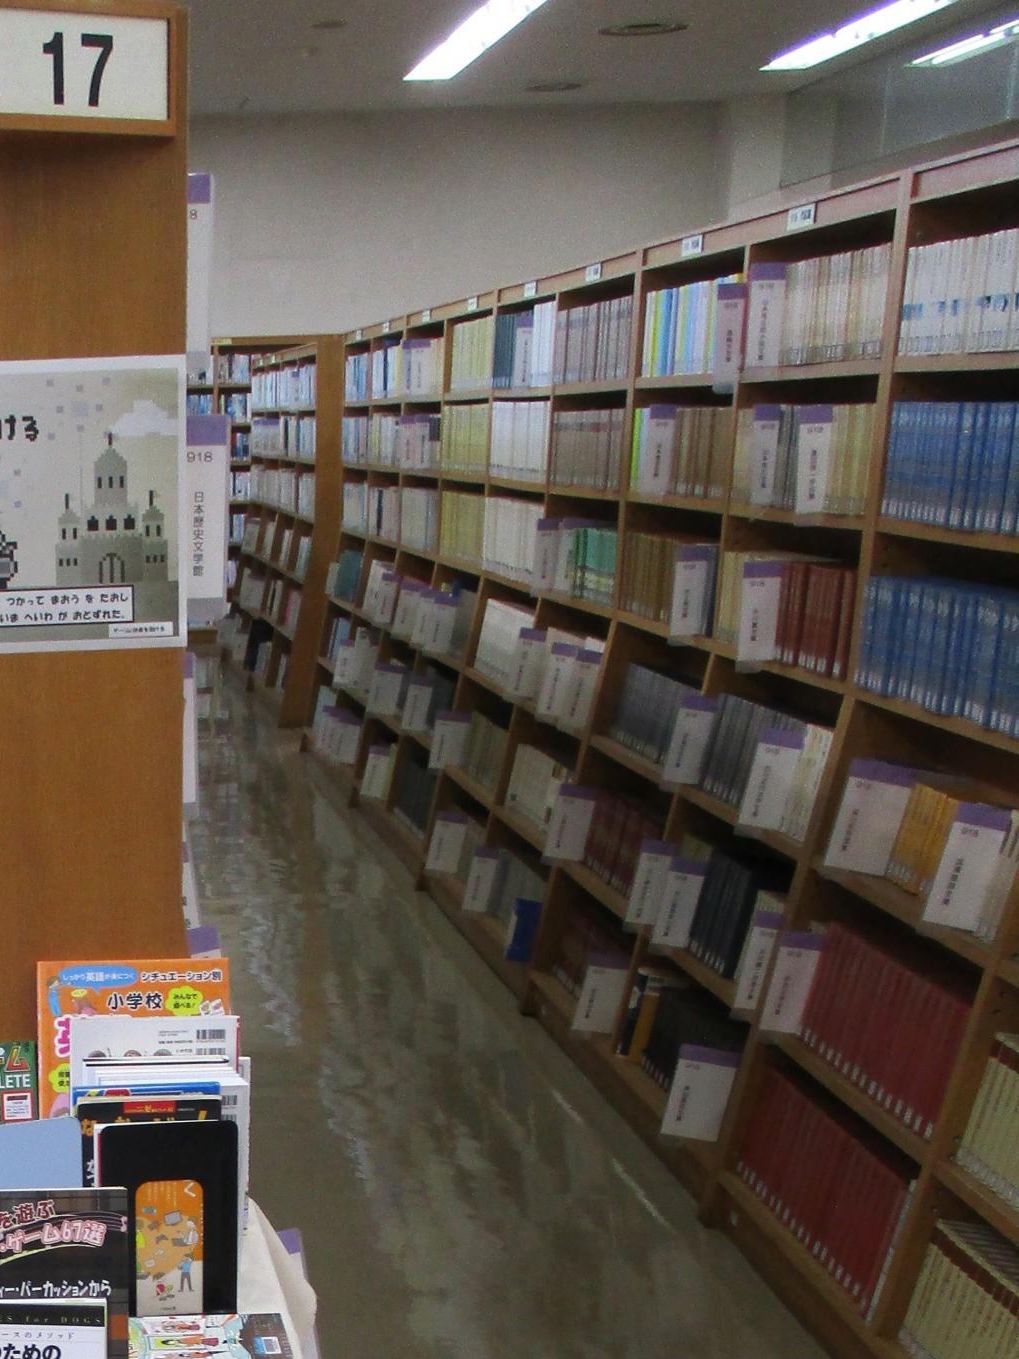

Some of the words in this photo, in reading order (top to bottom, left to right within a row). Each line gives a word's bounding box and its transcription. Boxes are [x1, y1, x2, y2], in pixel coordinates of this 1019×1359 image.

[43, 32, 113, 107] 17
[187, 452, 212, 462] 918
[7, 596, 45, 606] つかって
[51, 594, 78, 605] まおう
[100, 593, 128, 603] たおし
[0, 613, 18, 623] いま
[24, 612, 53, 621] へいわ
[58, 611, 67, 620] が
[72, 609, 125, 621] おとずれた。
[140, 971, 222, 983] シチュエーション別
[107, 991, 163, 1010] 小学校
